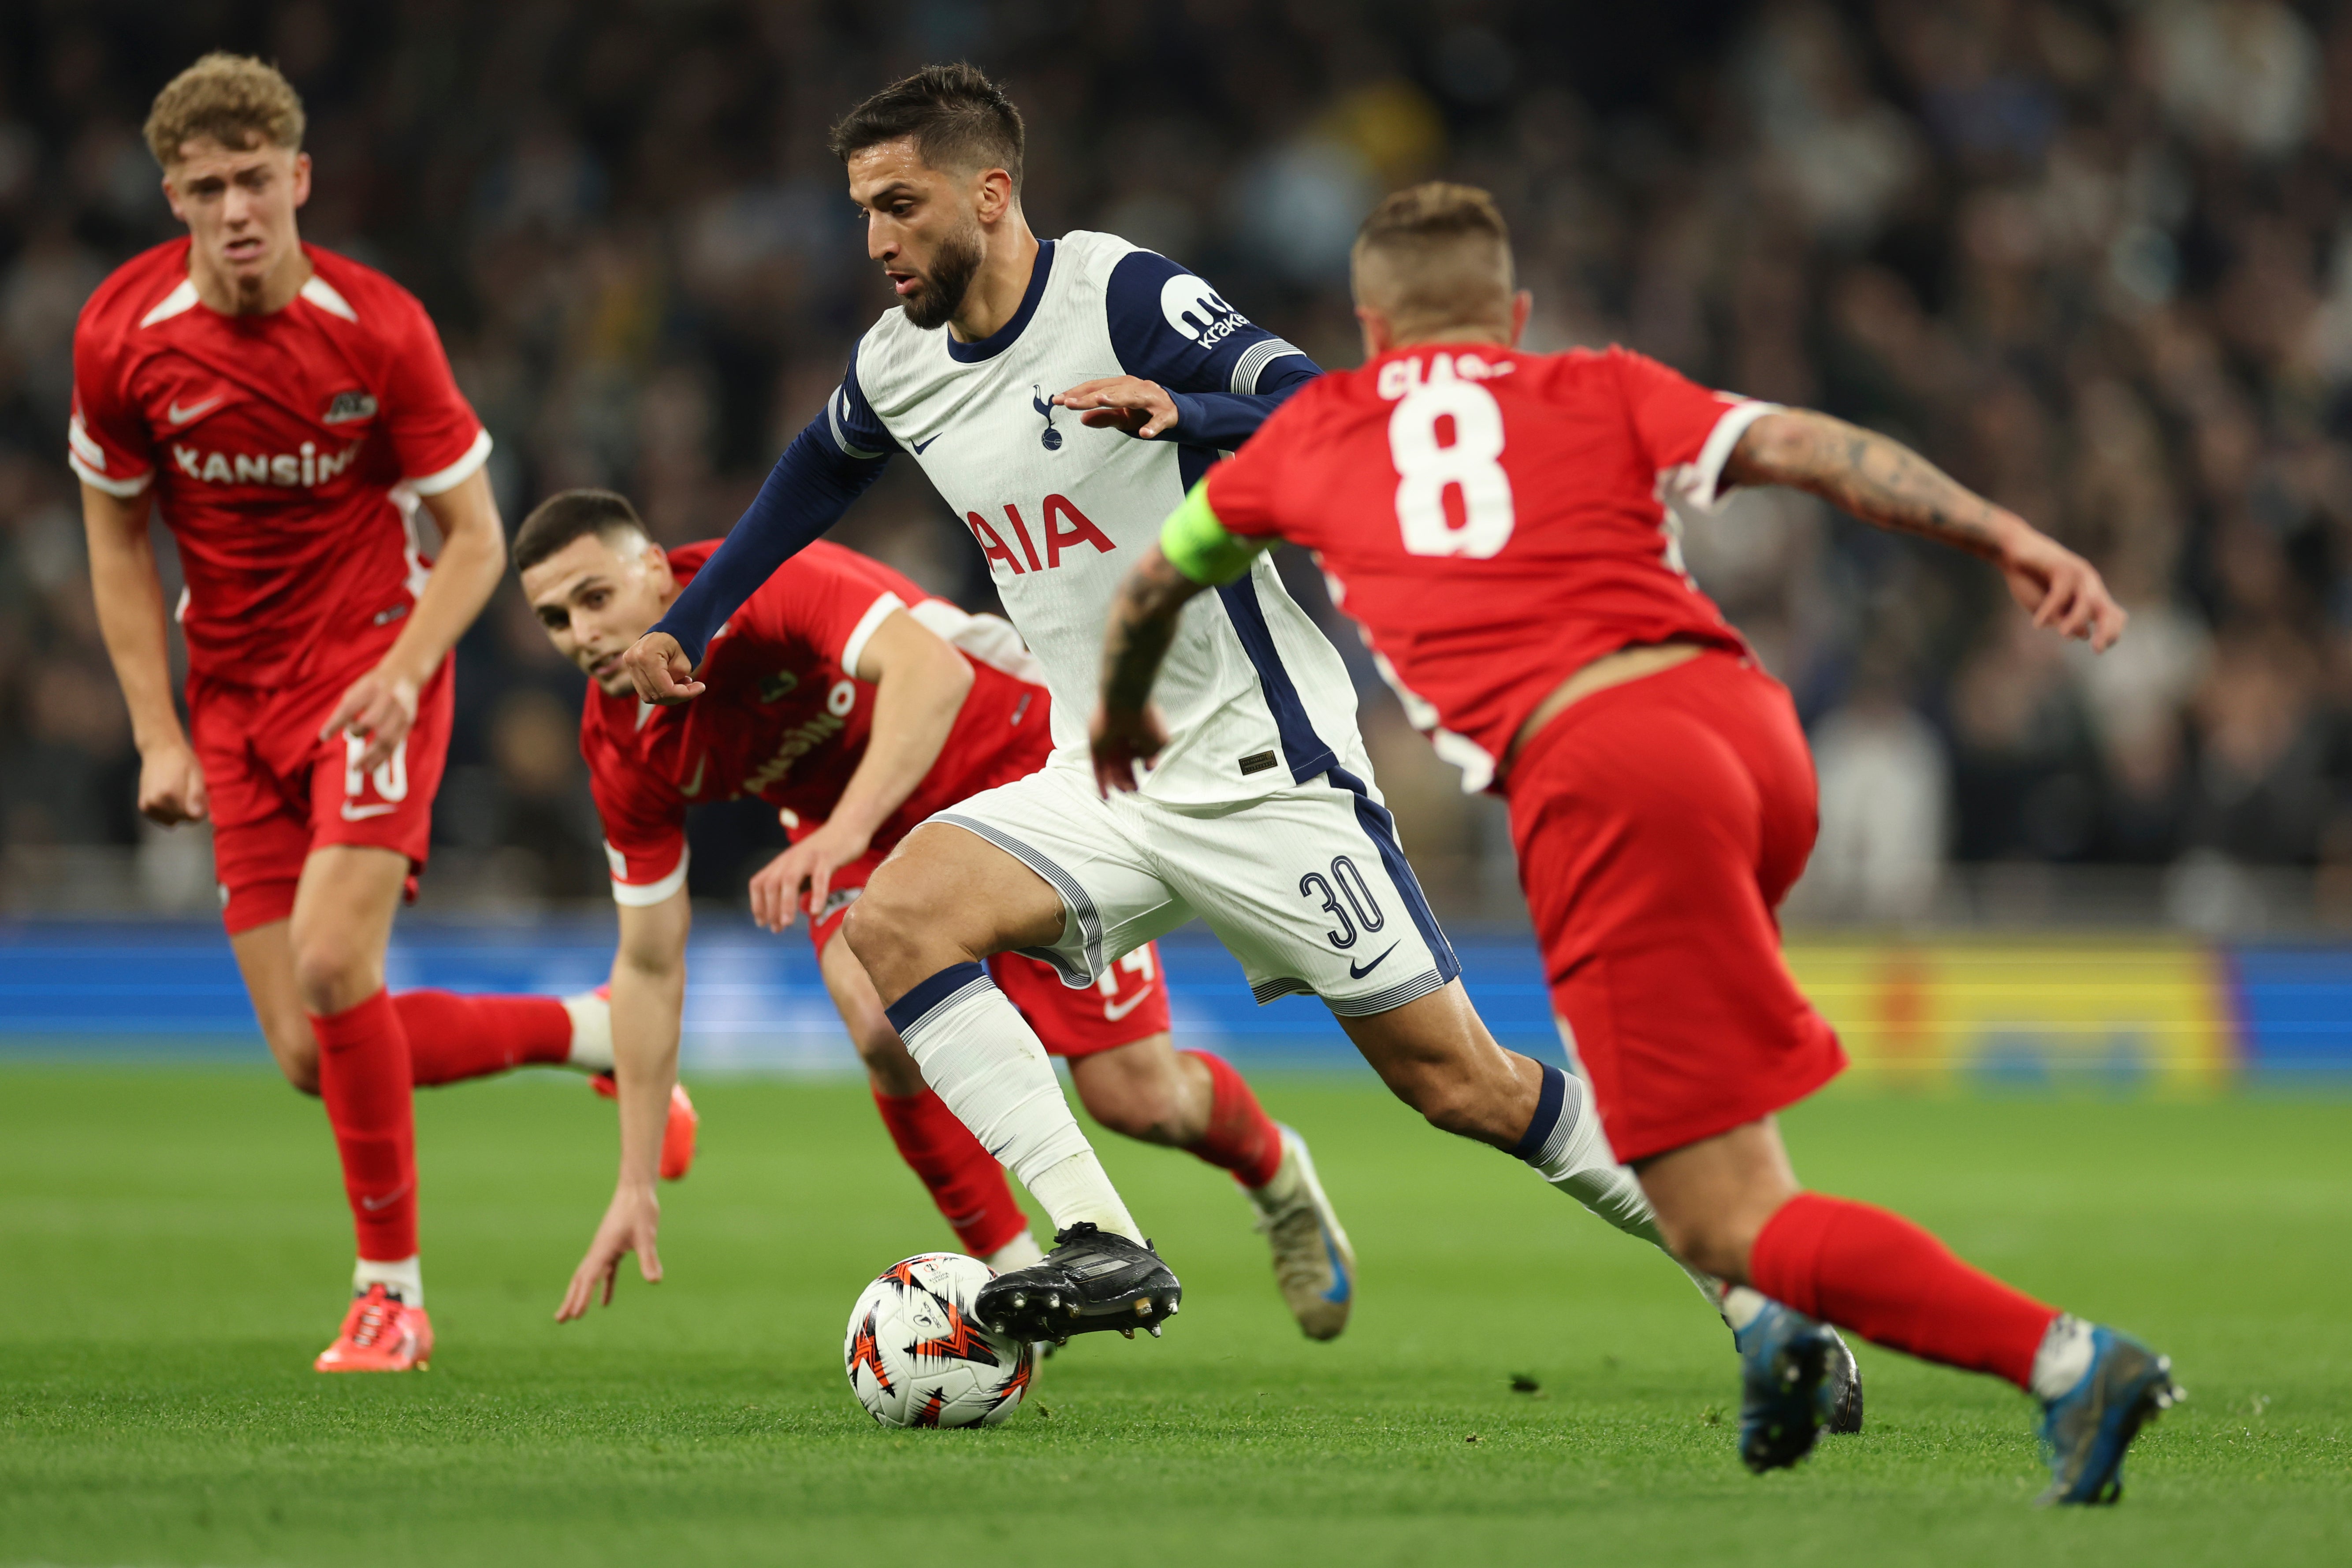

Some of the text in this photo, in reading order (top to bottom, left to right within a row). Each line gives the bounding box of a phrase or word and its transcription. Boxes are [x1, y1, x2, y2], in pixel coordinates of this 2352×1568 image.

[1387, 377, 1515, 560] 8
[967, 494, 1116, 575] AIA
[343, 724, 408, 802] 10
[1299, 855, 1384, 950] 30
[929, 1272, 949, 1282] EUROPA
